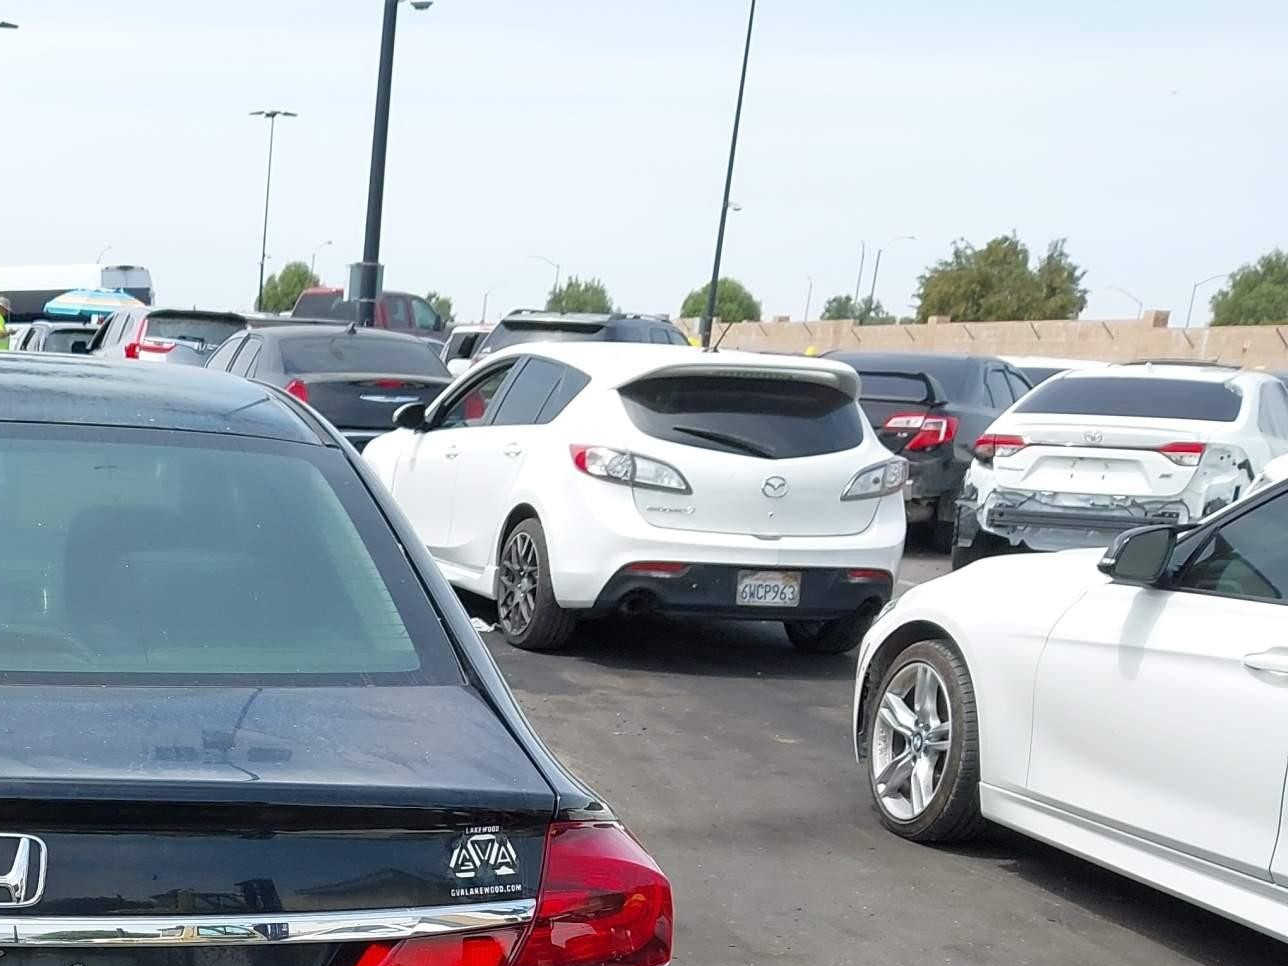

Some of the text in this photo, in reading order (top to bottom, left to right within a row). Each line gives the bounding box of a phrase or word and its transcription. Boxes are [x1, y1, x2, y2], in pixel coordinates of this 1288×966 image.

[741, 583, 796, 601] 6WCP963
[465, 825, 500, 835] LAKEWOOD
[450, 884, 522, 897] GVALAKEWOOD.COM
